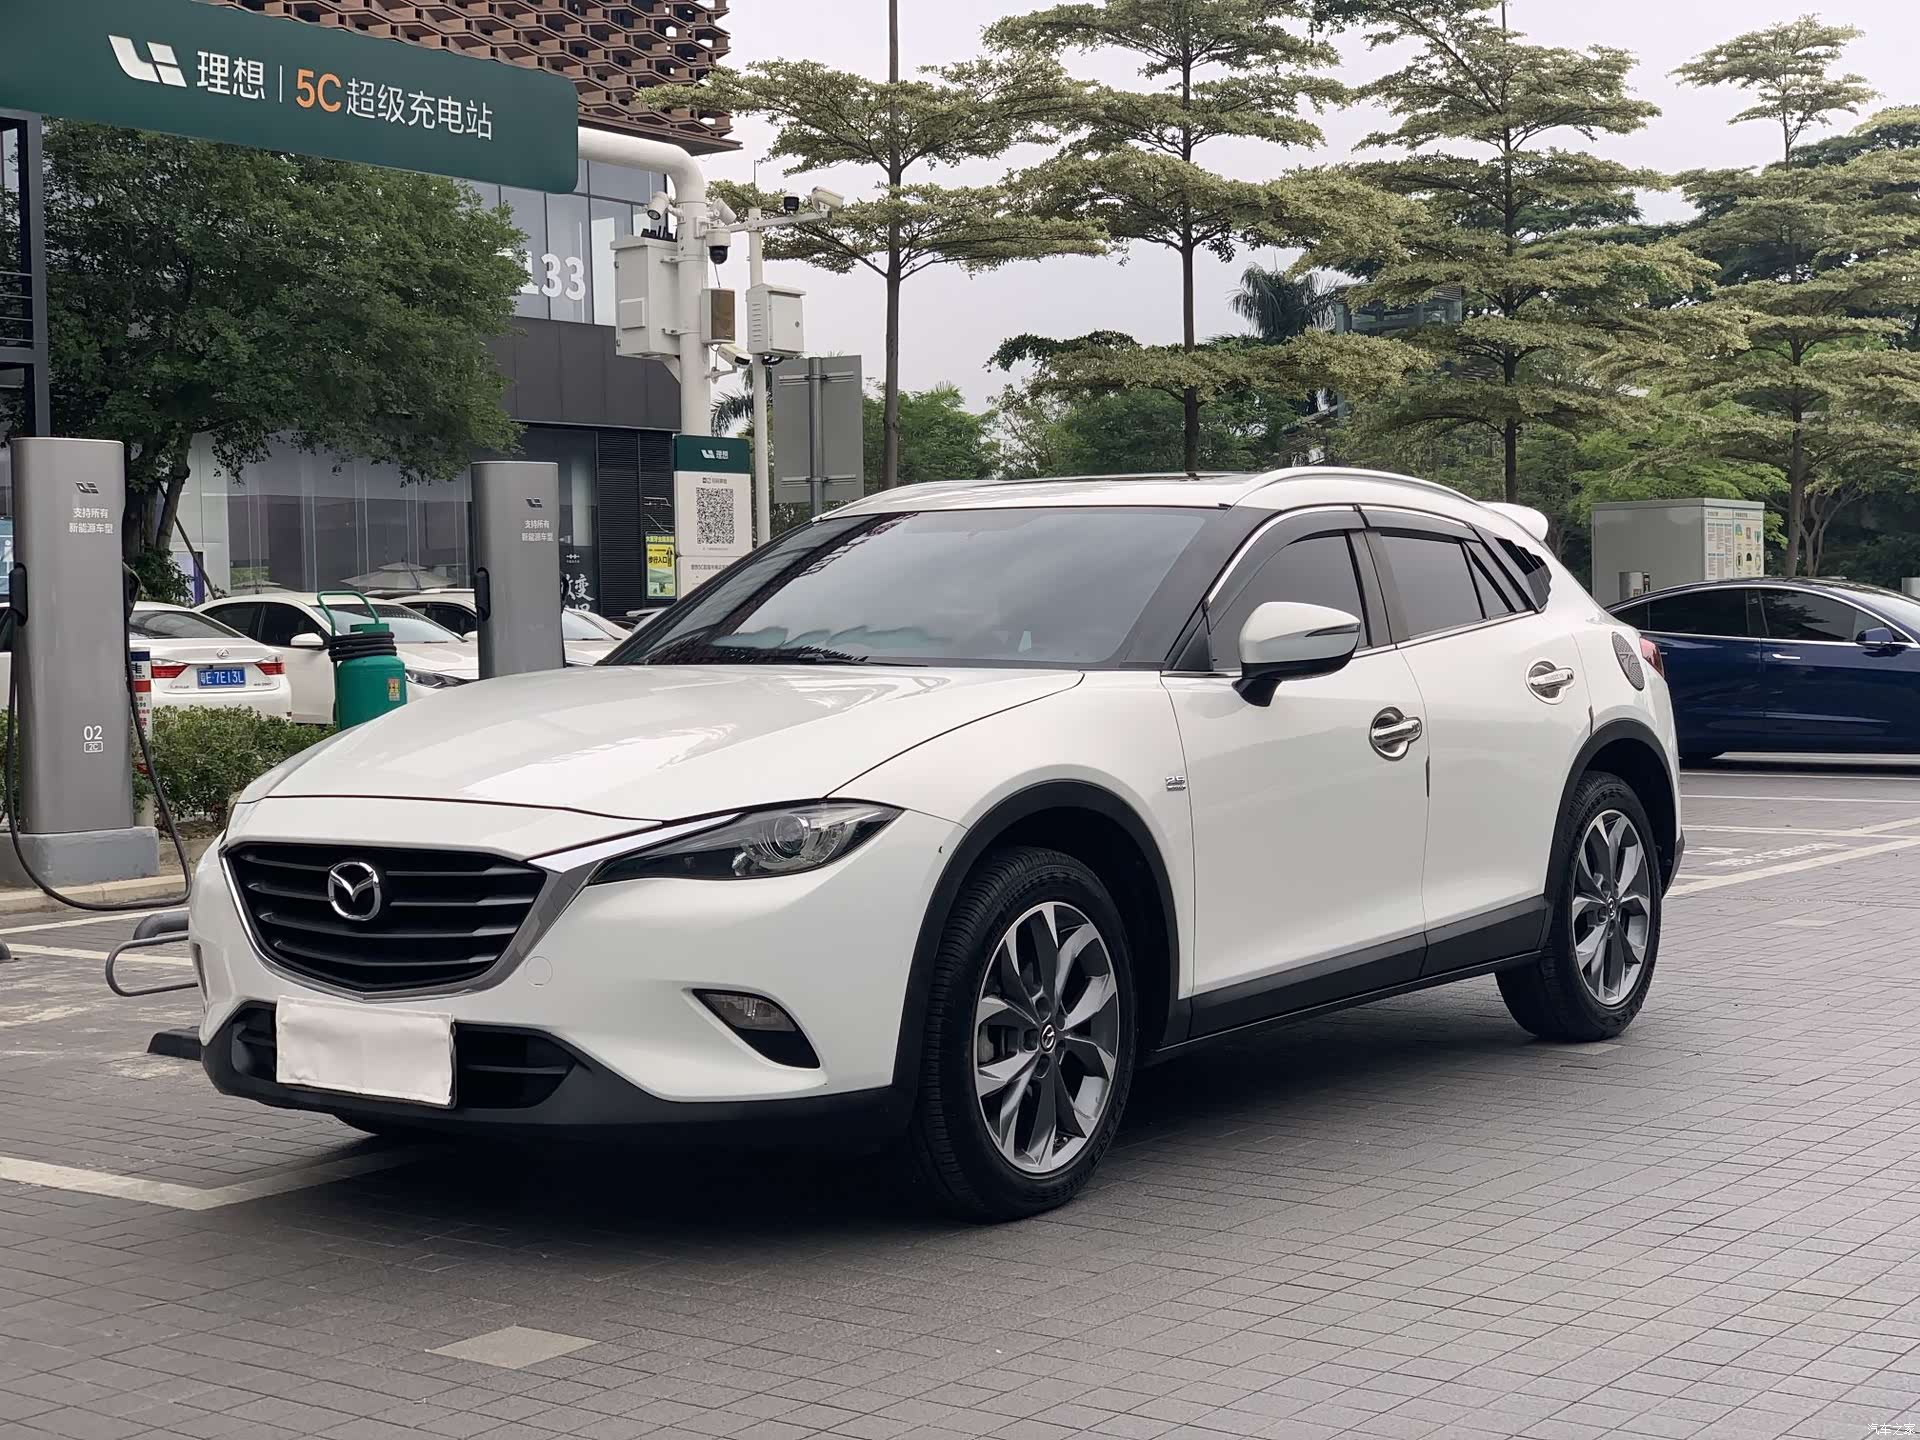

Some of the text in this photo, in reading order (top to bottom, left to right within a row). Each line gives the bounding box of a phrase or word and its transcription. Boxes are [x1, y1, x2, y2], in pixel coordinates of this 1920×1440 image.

[196, 50, 266, 101] 理想
[73, 507, 109, 519] 支持所有
[69, 522, 113, 534] 新能源车型
[524, 519, 550, 529] 支持所有
[84, 725, 103, 741] 02
